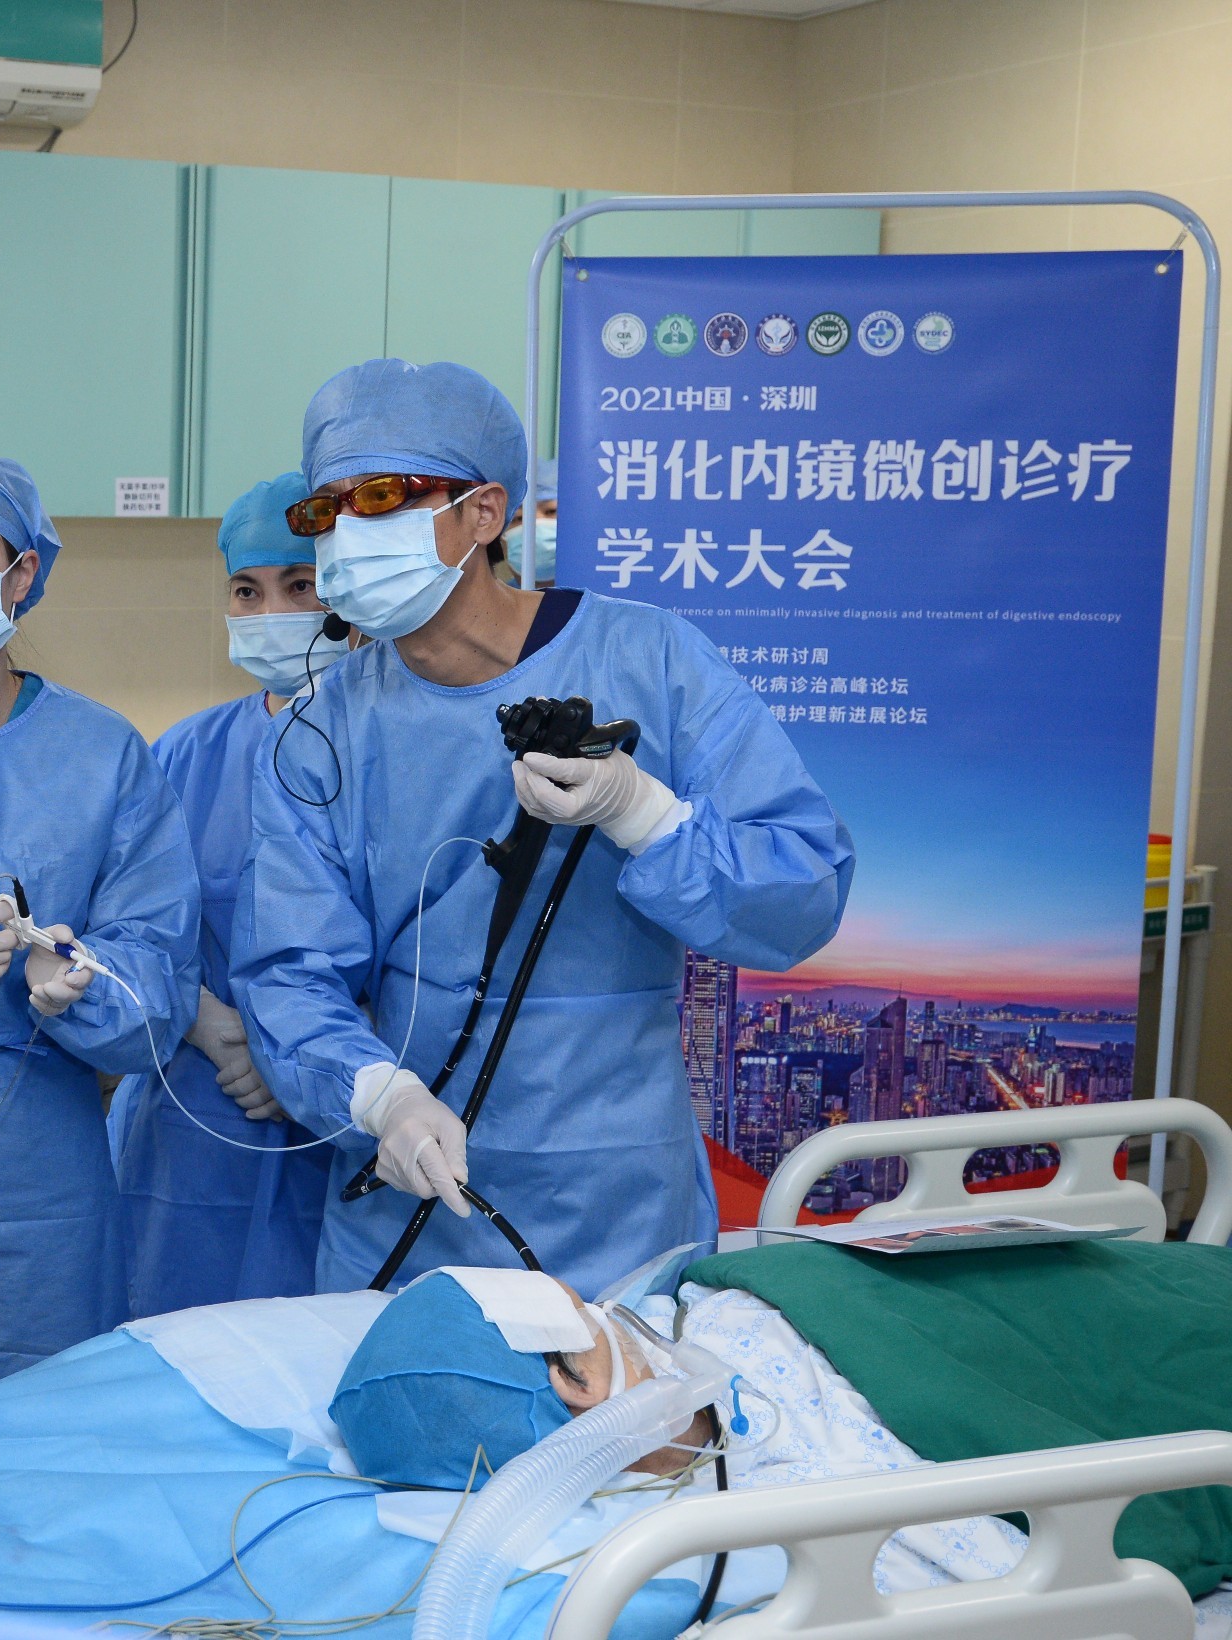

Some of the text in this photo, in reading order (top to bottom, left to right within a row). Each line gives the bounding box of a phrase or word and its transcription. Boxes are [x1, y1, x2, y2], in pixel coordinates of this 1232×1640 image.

[597, 438, 1133, 501] 消化内镜微创诊疗
[595, 527, 854, 591] 学术大会
[717, 608, 731, 616] on
[735, 606, 790, 620] minimally
[794, 607, 840, 618] invasive
[843, 608, 897, 620] diagnosis
[901, 609, 922, 619] and
[926, 609, 983, 619] treatment
[987, 610, 999, 620] of
[1002, 610, 1055, 623] digestive
[1058, 611, 1122, 624] endoscopy
[739, 675, 909, 695] 化病诊治高峰论坛
[769, 704, 928, 724] 镜护理新进展论坛
